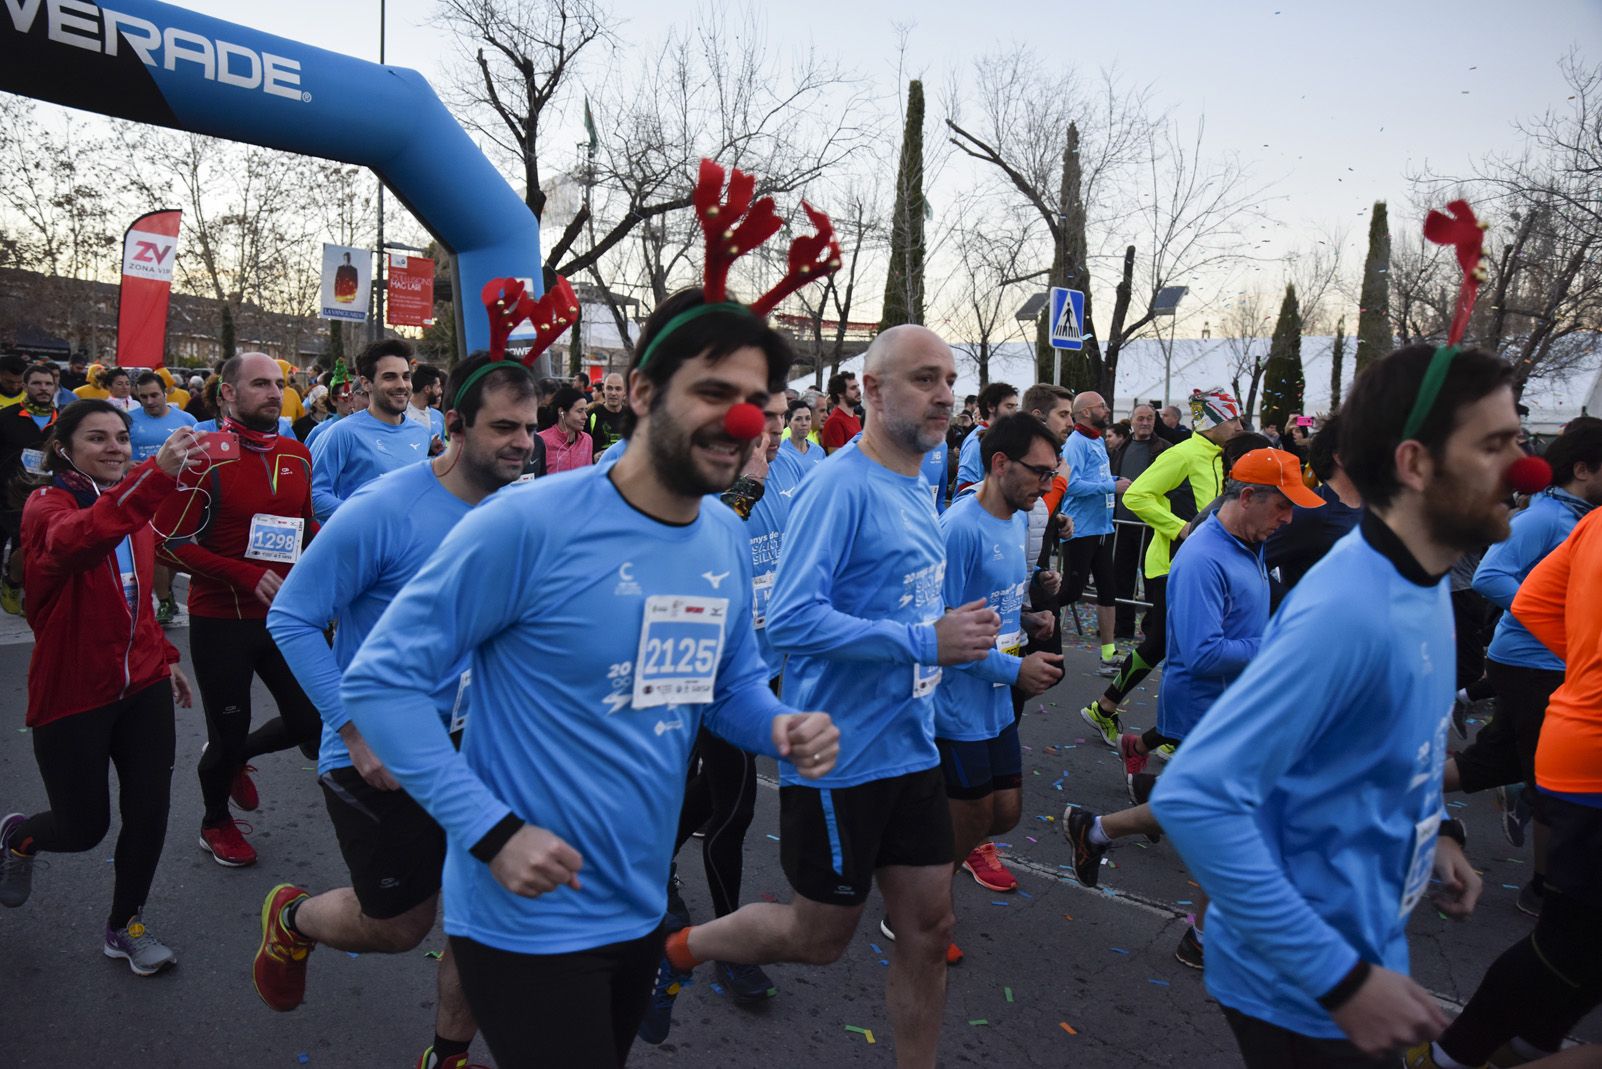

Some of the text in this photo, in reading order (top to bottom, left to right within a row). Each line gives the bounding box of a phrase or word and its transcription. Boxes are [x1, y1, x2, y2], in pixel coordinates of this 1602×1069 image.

[128, 263, 155, 273] ZONA
[254, 531, 295, 551] 1298
[769, 531, 779, 539] de
[643, 637, 718, 675] 2125
[607, 661, 632, 679] 20
